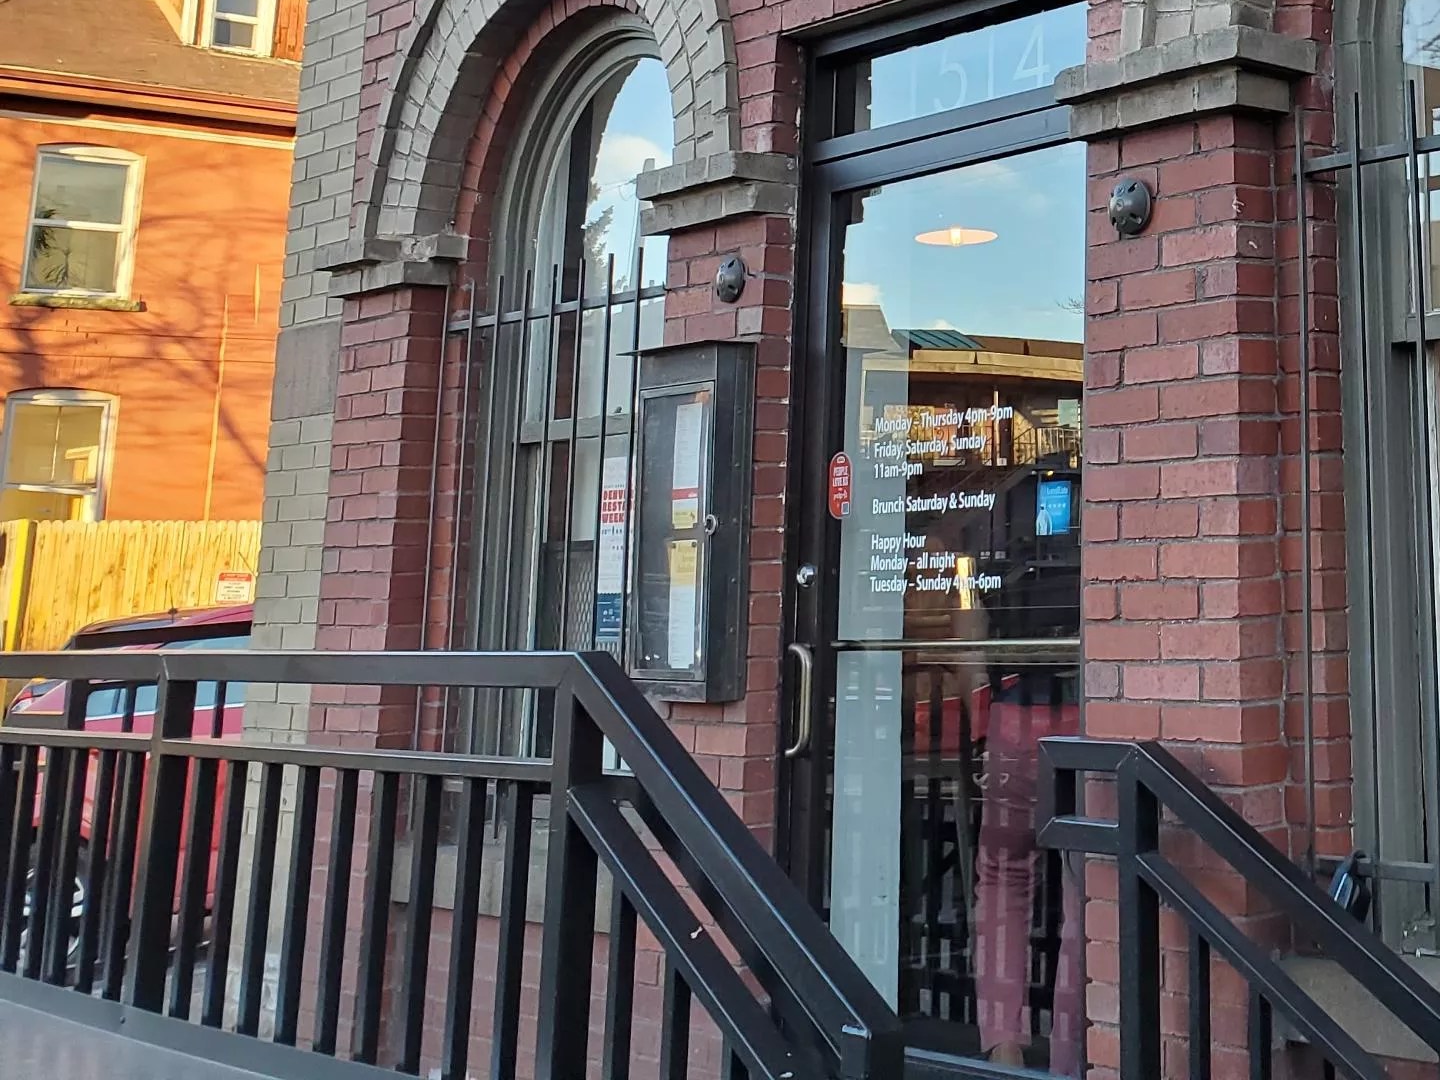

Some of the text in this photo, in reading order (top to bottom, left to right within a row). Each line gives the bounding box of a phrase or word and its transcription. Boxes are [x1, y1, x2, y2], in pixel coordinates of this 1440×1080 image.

[908, 23, 1051, 118] 1514
[874, 415, 912, 434] Monday
[920, 409, 965, 429] Thursday
[965, 405, 1013, 426] 4pm-9pm
[874, 434, 987, 460] Friday, Saturday, Sunday
[874, 462, 923, 480] 11am-9pm
[872, 490, 996, 515] Brunch Saturday & Sunday
[871, 532, 927, 553] Happy Hour
[870, 553, 908, 573] Monday
[916, 552, 928, 570] all
[929, 551, 956, 572] night
[870, 575, 908, 595] Tuesday
[916, 573, 952, 595] Sunday
